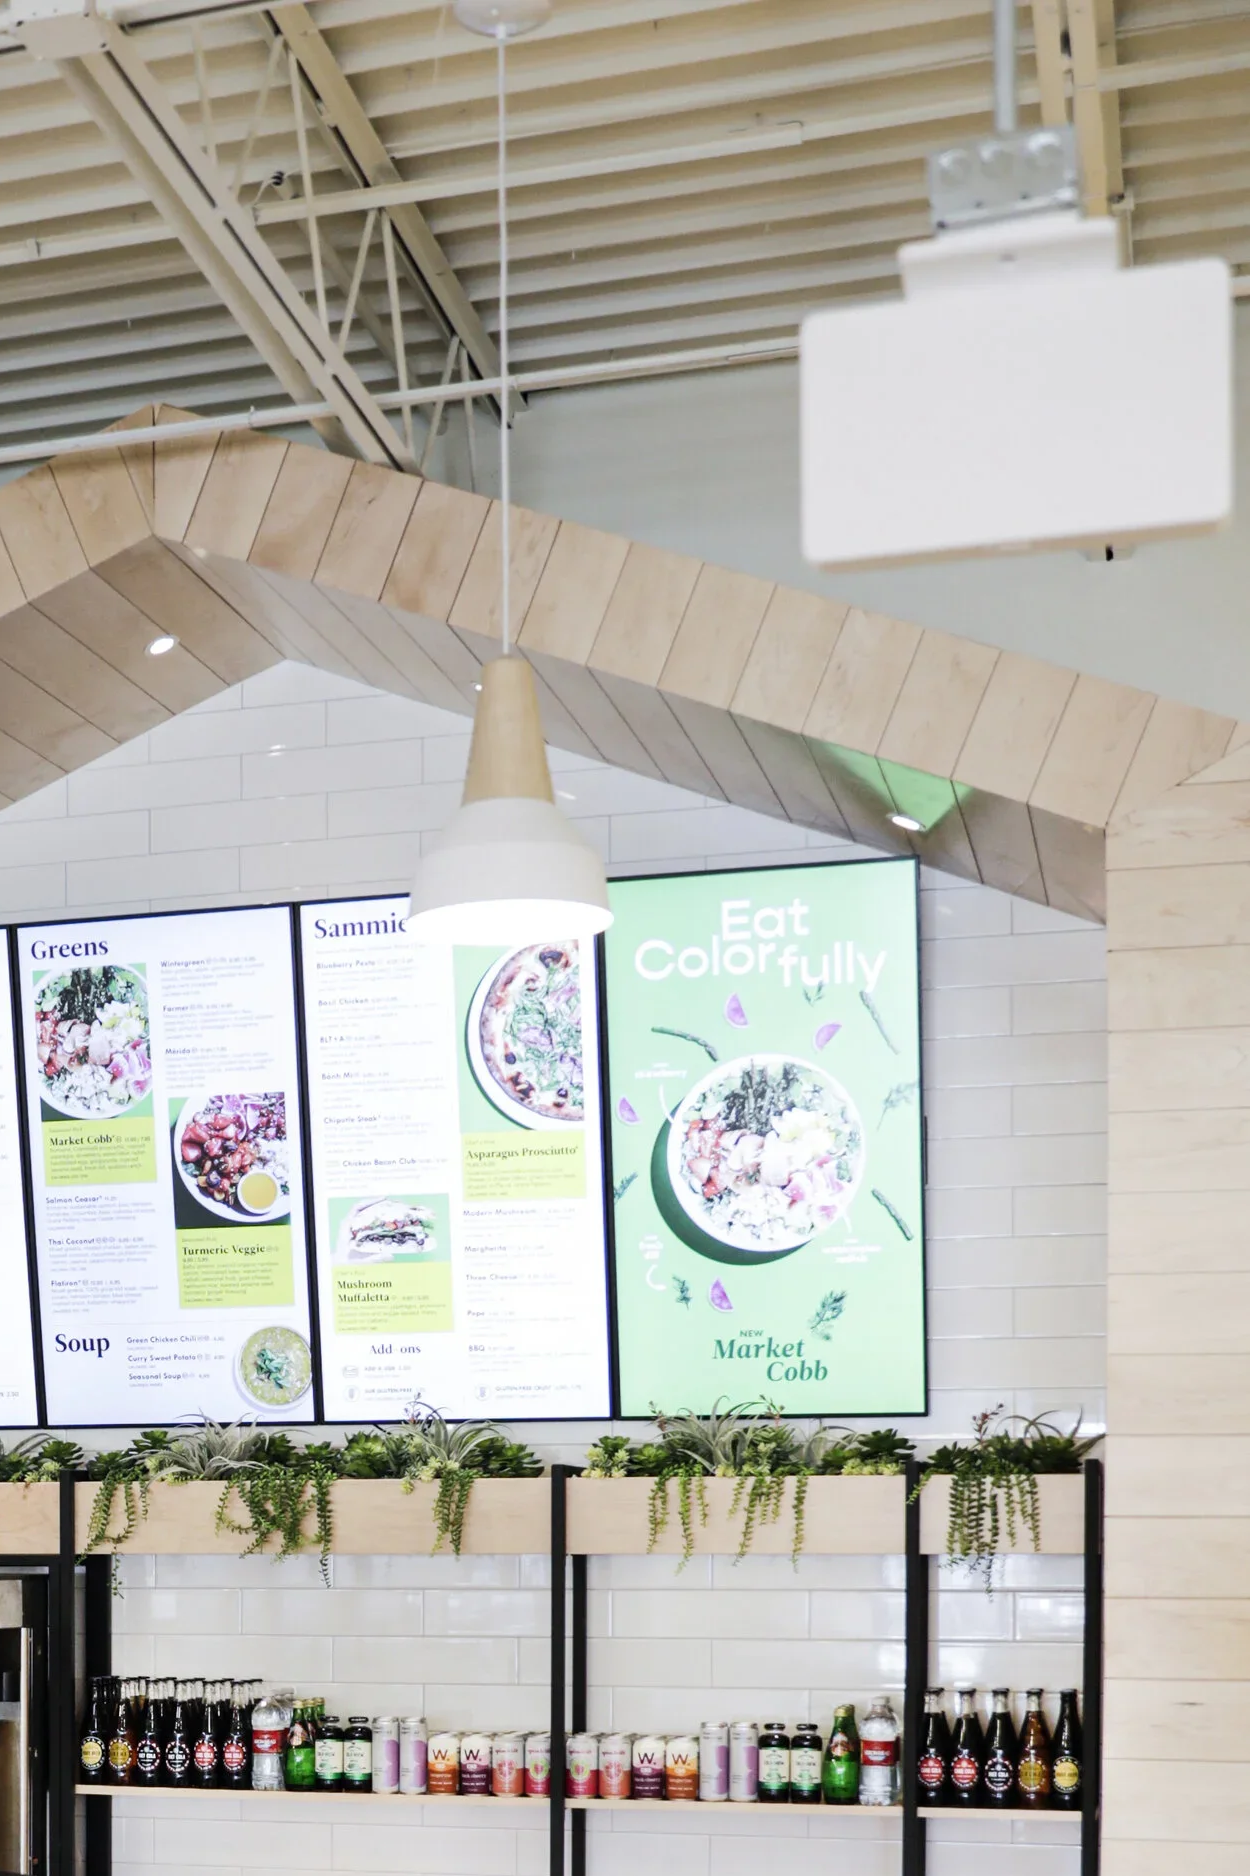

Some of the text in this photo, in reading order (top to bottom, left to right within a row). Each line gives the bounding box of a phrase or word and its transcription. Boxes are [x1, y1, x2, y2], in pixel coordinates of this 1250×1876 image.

[720, 897, 810, 941] Eat
[31, 939, 109, 960] Greens
[160, 959, 205, 968] Wintergreen
[634, 934, 887, 996] Colorfully
[50, 1136, 84, 1146] Market
[466, 1149, 519, 1161] Asparagus
[65, 1237, 95, 1245] Coconut
[182, 1243, 266, 1257] Turmeric Veggie
[336, 1280, 392, 1290] Mushroom
[337, 1292, 390, 1303] Muffaletta
[126, 1335, 197, 1344] Green Chicken Chili
[55, 1333, 110, 1358] Soup
[712, 1337, 806, 1360] Market
[127, 1355, 149, 1364] Curry
[149, 1353, 172, 1362] Sweet
[163, 1372, 181, 1381] Soup
[766, 1360, 829, 1382] Cobb
